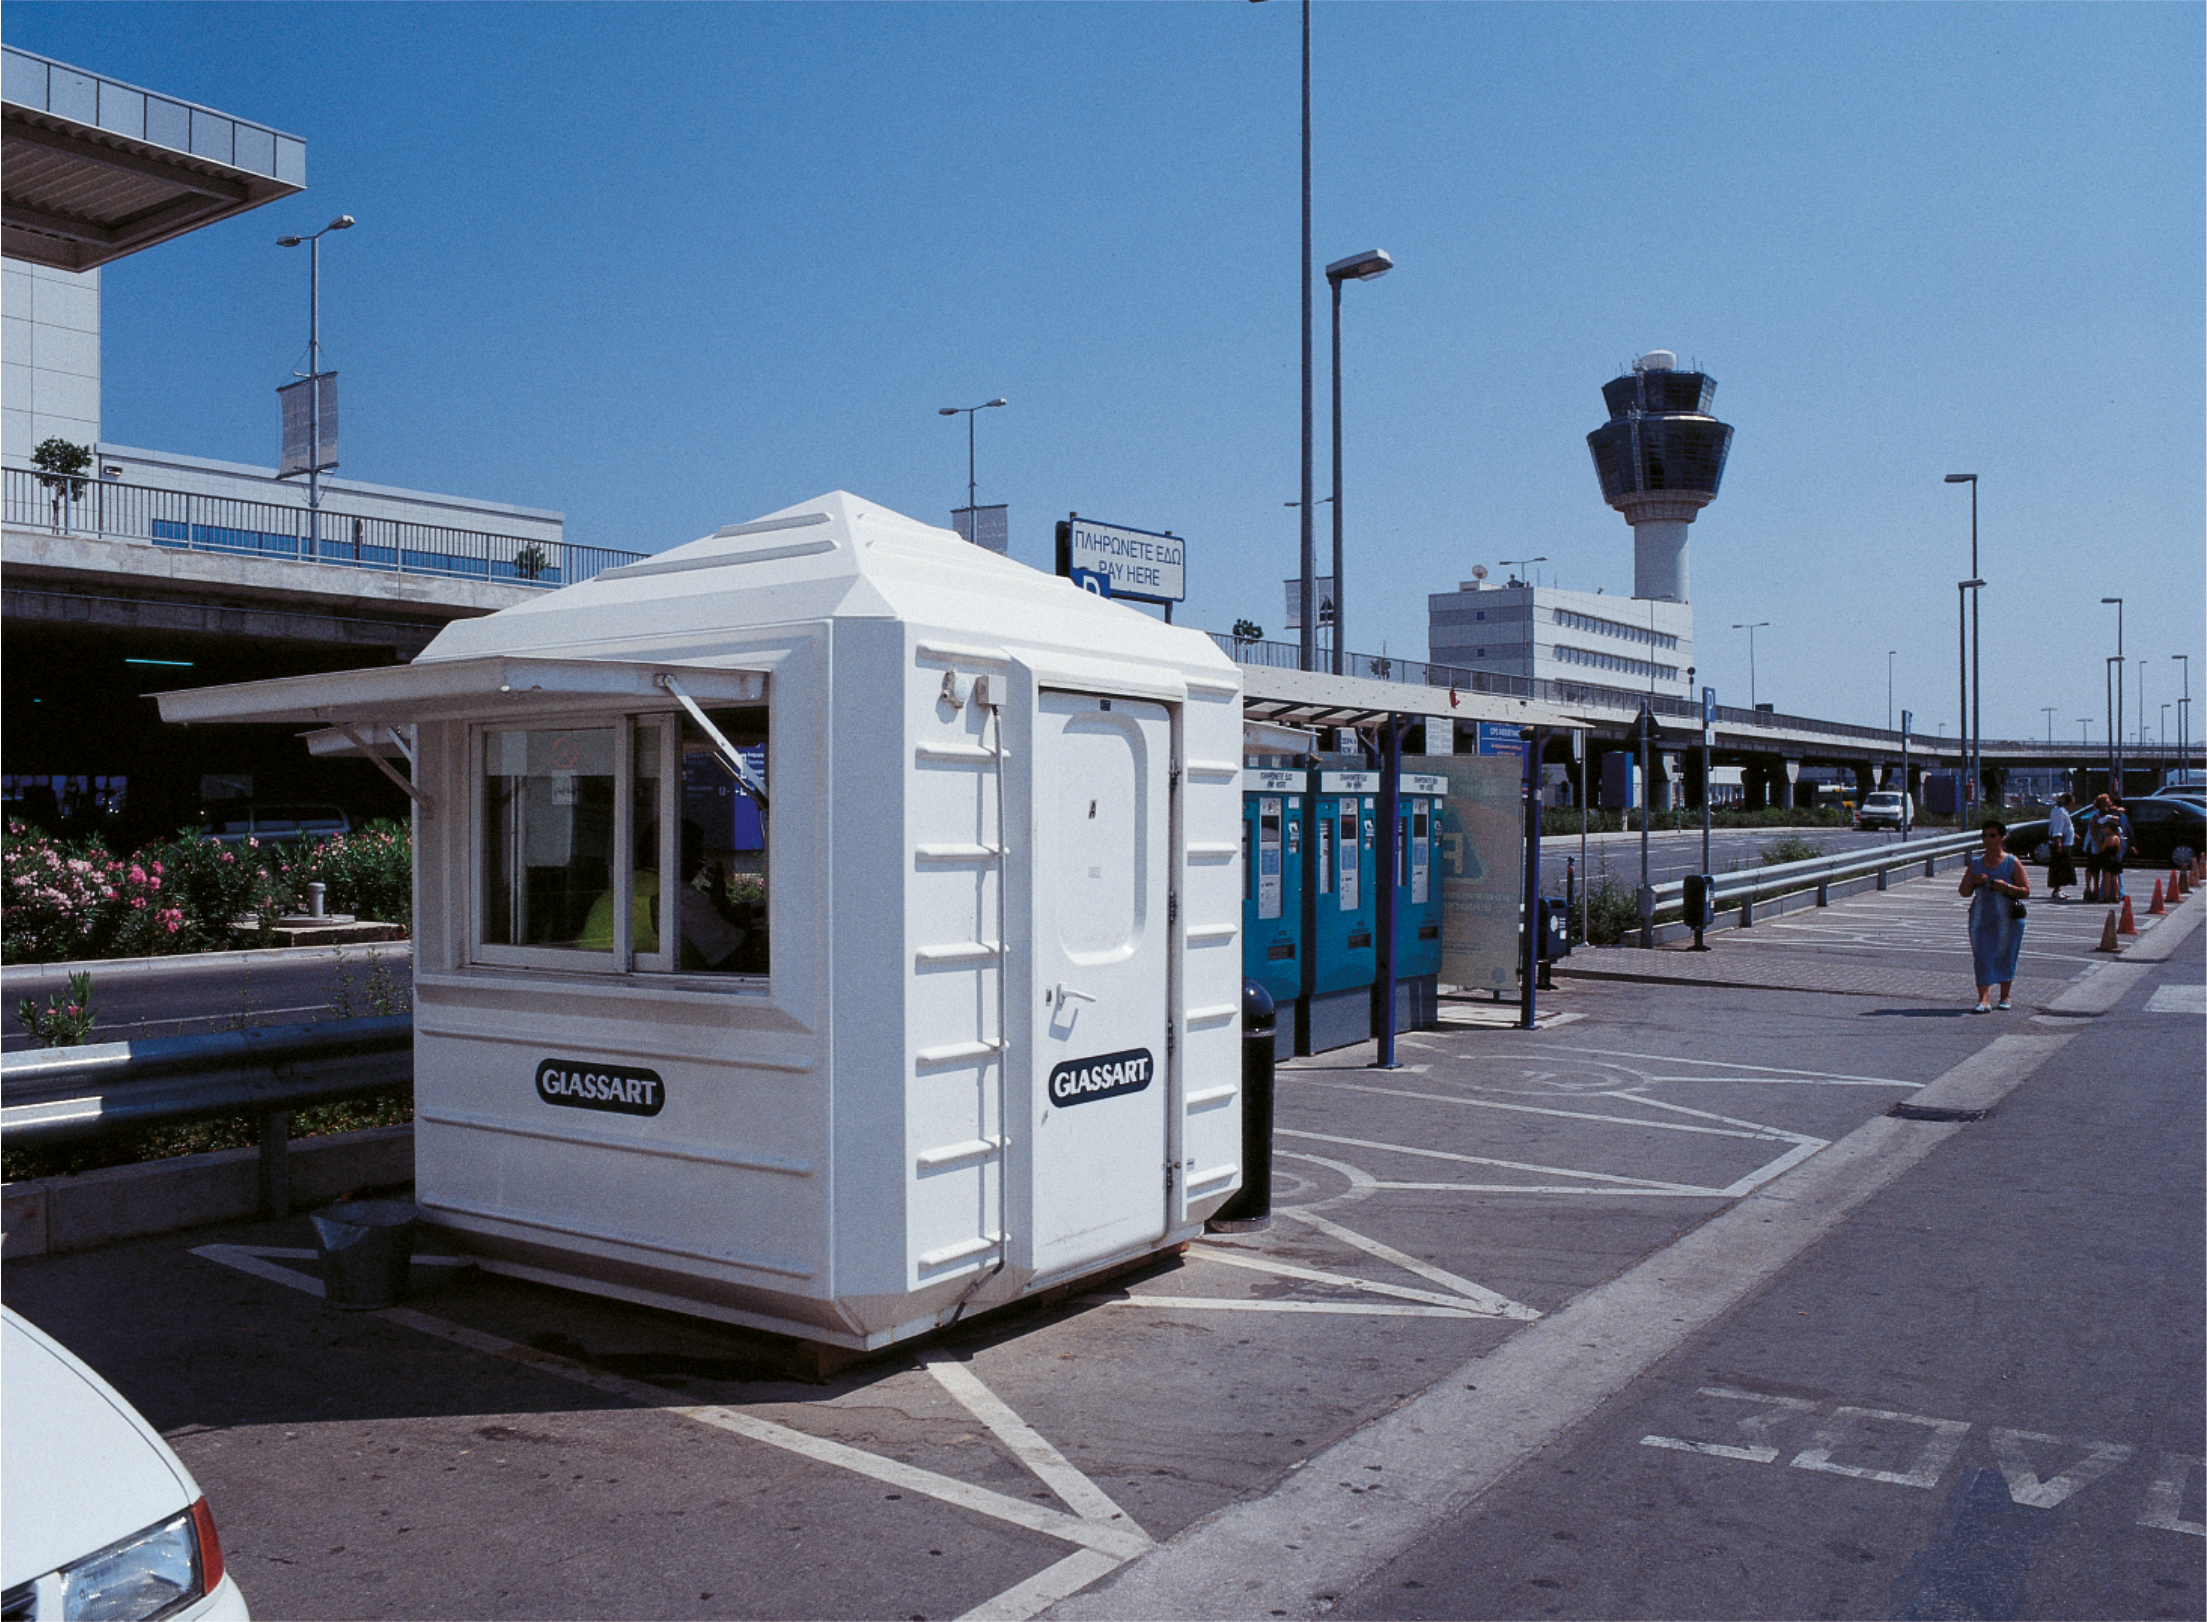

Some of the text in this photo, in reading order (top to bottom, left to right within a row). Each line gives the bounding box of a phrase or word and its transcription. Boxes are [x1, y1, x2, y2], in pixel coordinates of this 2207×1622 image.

[1075, 530, 1182, 566] ΠΛΗΡΩΝΕΤΕ ΕΔΩ
[1098, 559, 1160, 587] PAY HERE
[542, 1068, 657, 1106] GLASSART
[1054, 1057, 1149, 1098] GLASSART
